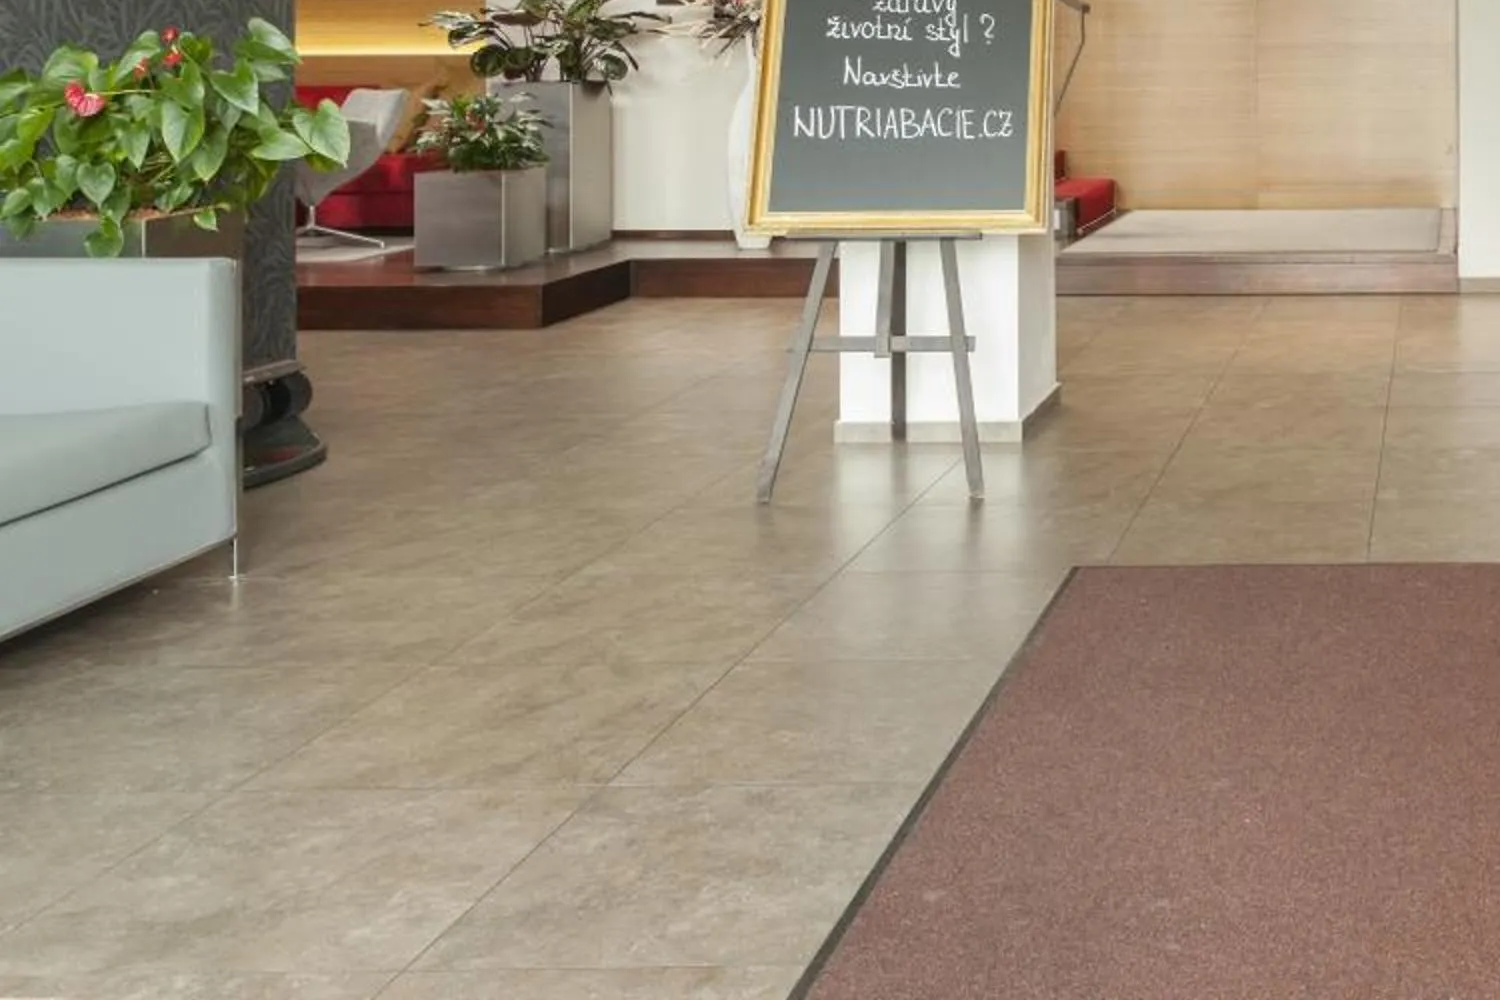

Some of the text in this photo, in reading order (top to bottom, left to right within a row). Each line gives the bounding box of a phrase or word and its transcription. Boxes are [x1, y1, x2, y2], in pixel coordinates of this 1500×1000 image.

[826, 14, 913, 41] životní
[925, 14, 969, 58] styl
[793, 105, 1014, 140] NUTRIABACIE.CZ
